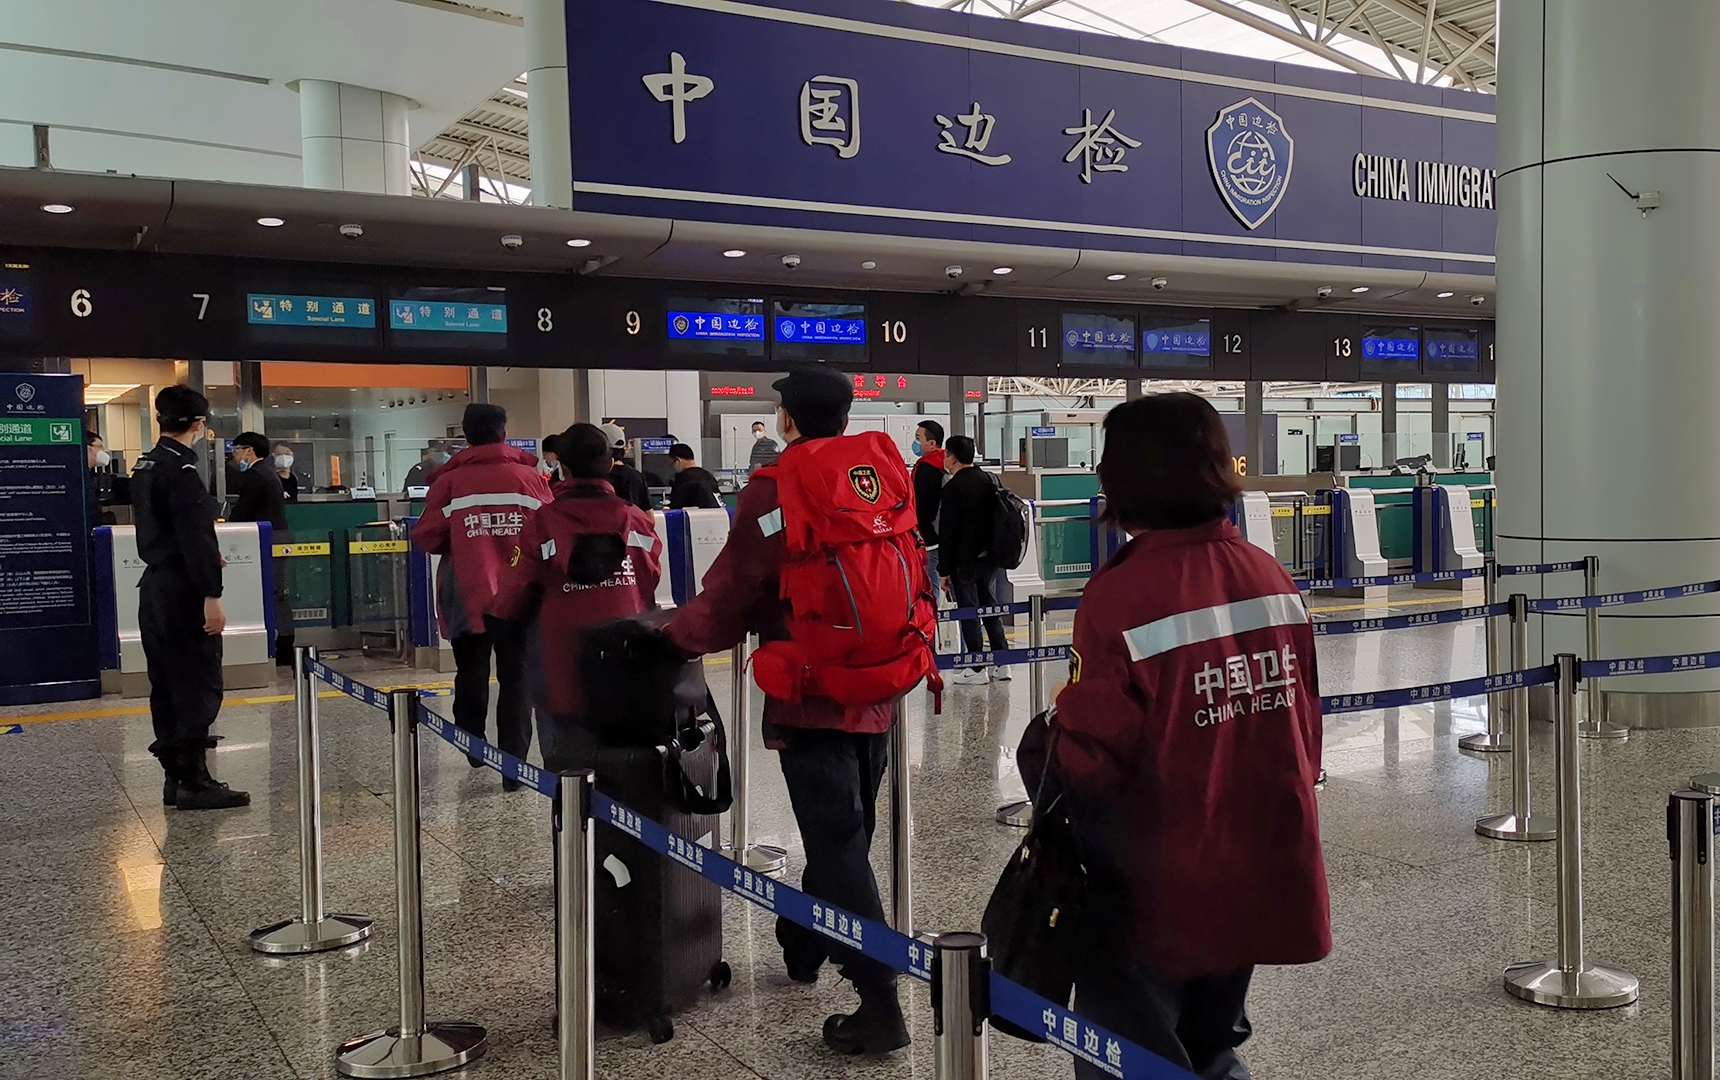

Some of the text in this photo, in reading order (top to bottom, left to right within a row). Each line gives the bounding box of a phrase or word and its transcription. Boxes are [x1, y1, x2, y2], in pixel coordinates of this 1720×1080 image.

[642, 51, 1142, 184] 中国边检
[1226, 113, 1278, 135] 中国边检
[1354, 152, 1410, 201] CHINA
[71, 289, 92, 317] 6
[192, 293, 210, 320] 7
[279, 299, 370, 315] 特别通道
[419, 305, 502, 320] 特别通道
[537, 308, 553, 332] 8
[626, 311, 640, 335] 9
[694, 316, 759, 332] 中国边检
[801, 321, 860, 335] 中国边检
[882, 320, 906, 343] 10
[1028, 327, 1047, 348] 11
[1082, 330, 1131, 344] 中国边检
[1223, 334, 1242, 353] 12
[1334, 338, 1351, 357] 13
[464, 511, 523, 529] 中国卫生
[1194, 644, 1297, 705] 中国卫生
[1194, 699, 1246, 727] CHINA
[611, 803, 642, 832] 中国边检
[668, 833, 703, 865] 中国边检
[733, 866, 775, 901] 中国边检
[812, 902, 863, 942] 中国边检
[1042, 1008, 1122, 1068] 中国边检
